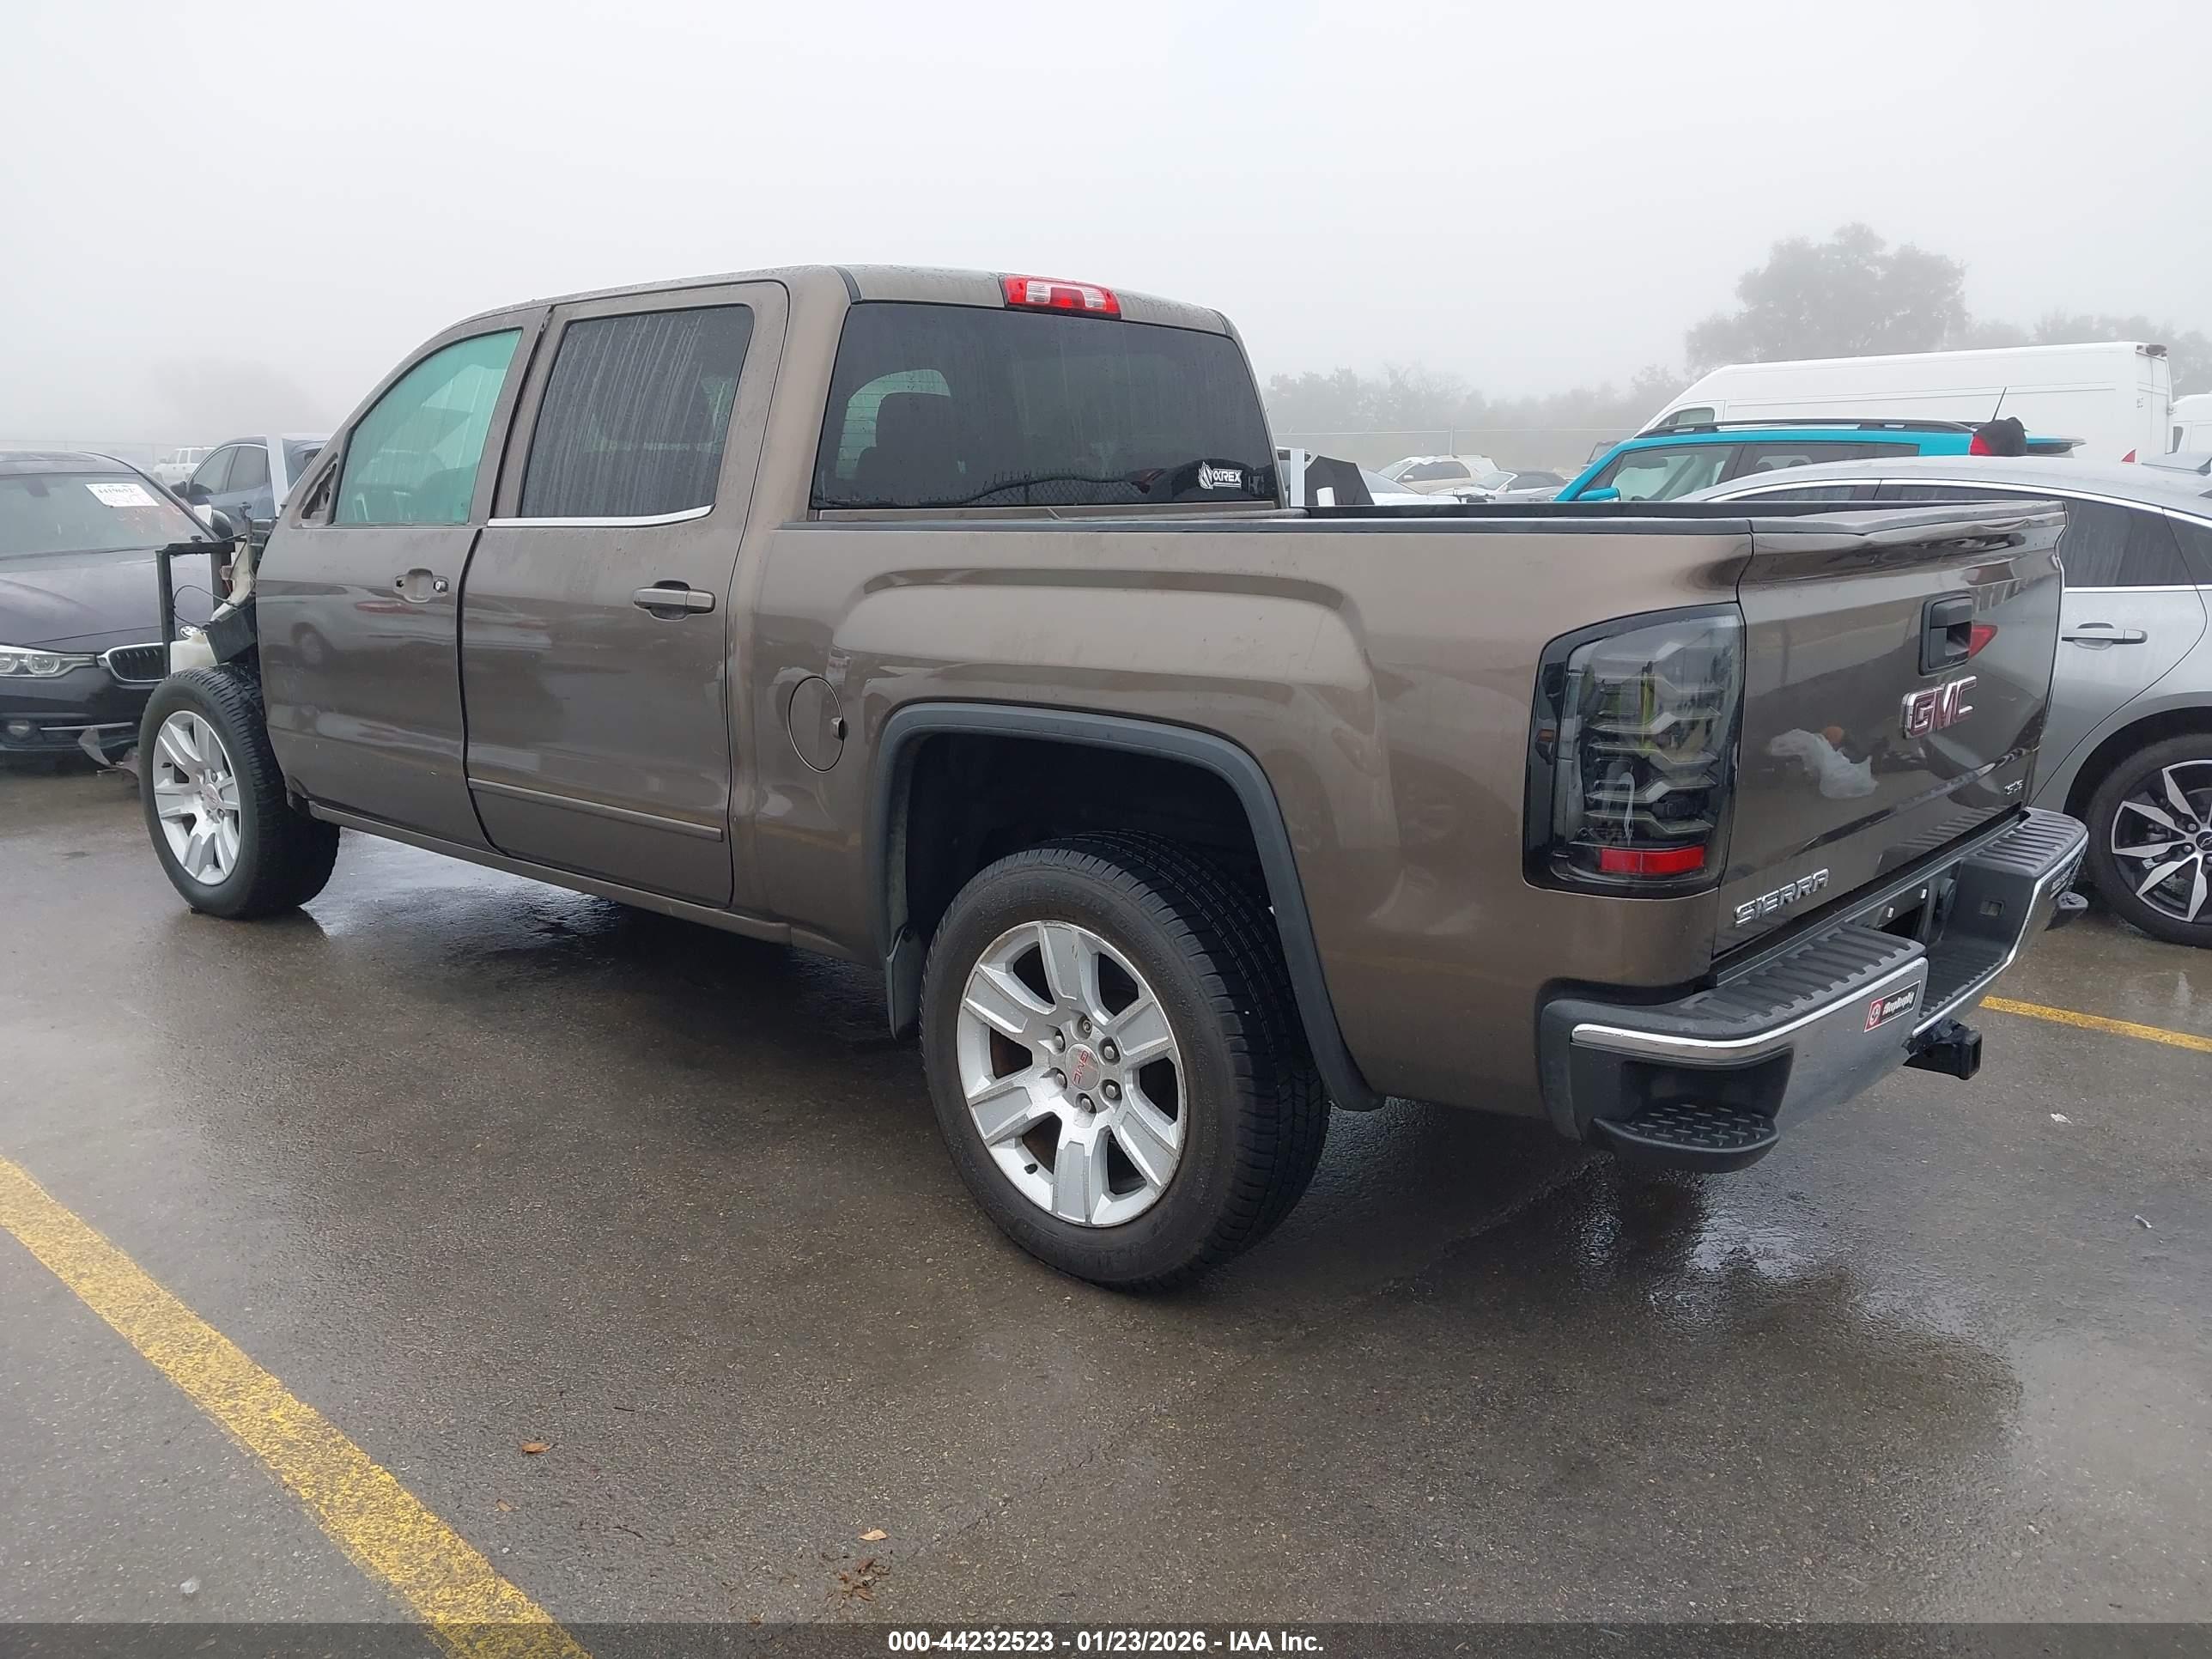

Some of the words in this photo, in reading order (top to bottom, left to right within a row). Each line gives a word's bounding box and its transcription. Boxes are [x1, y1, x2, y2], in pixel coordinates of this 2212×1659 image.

[1902, 675, 1978, 738] GMC
[1734, 867, 1829, 927] SIERRA
[1074, 1050, 1089, 1085] GMC
